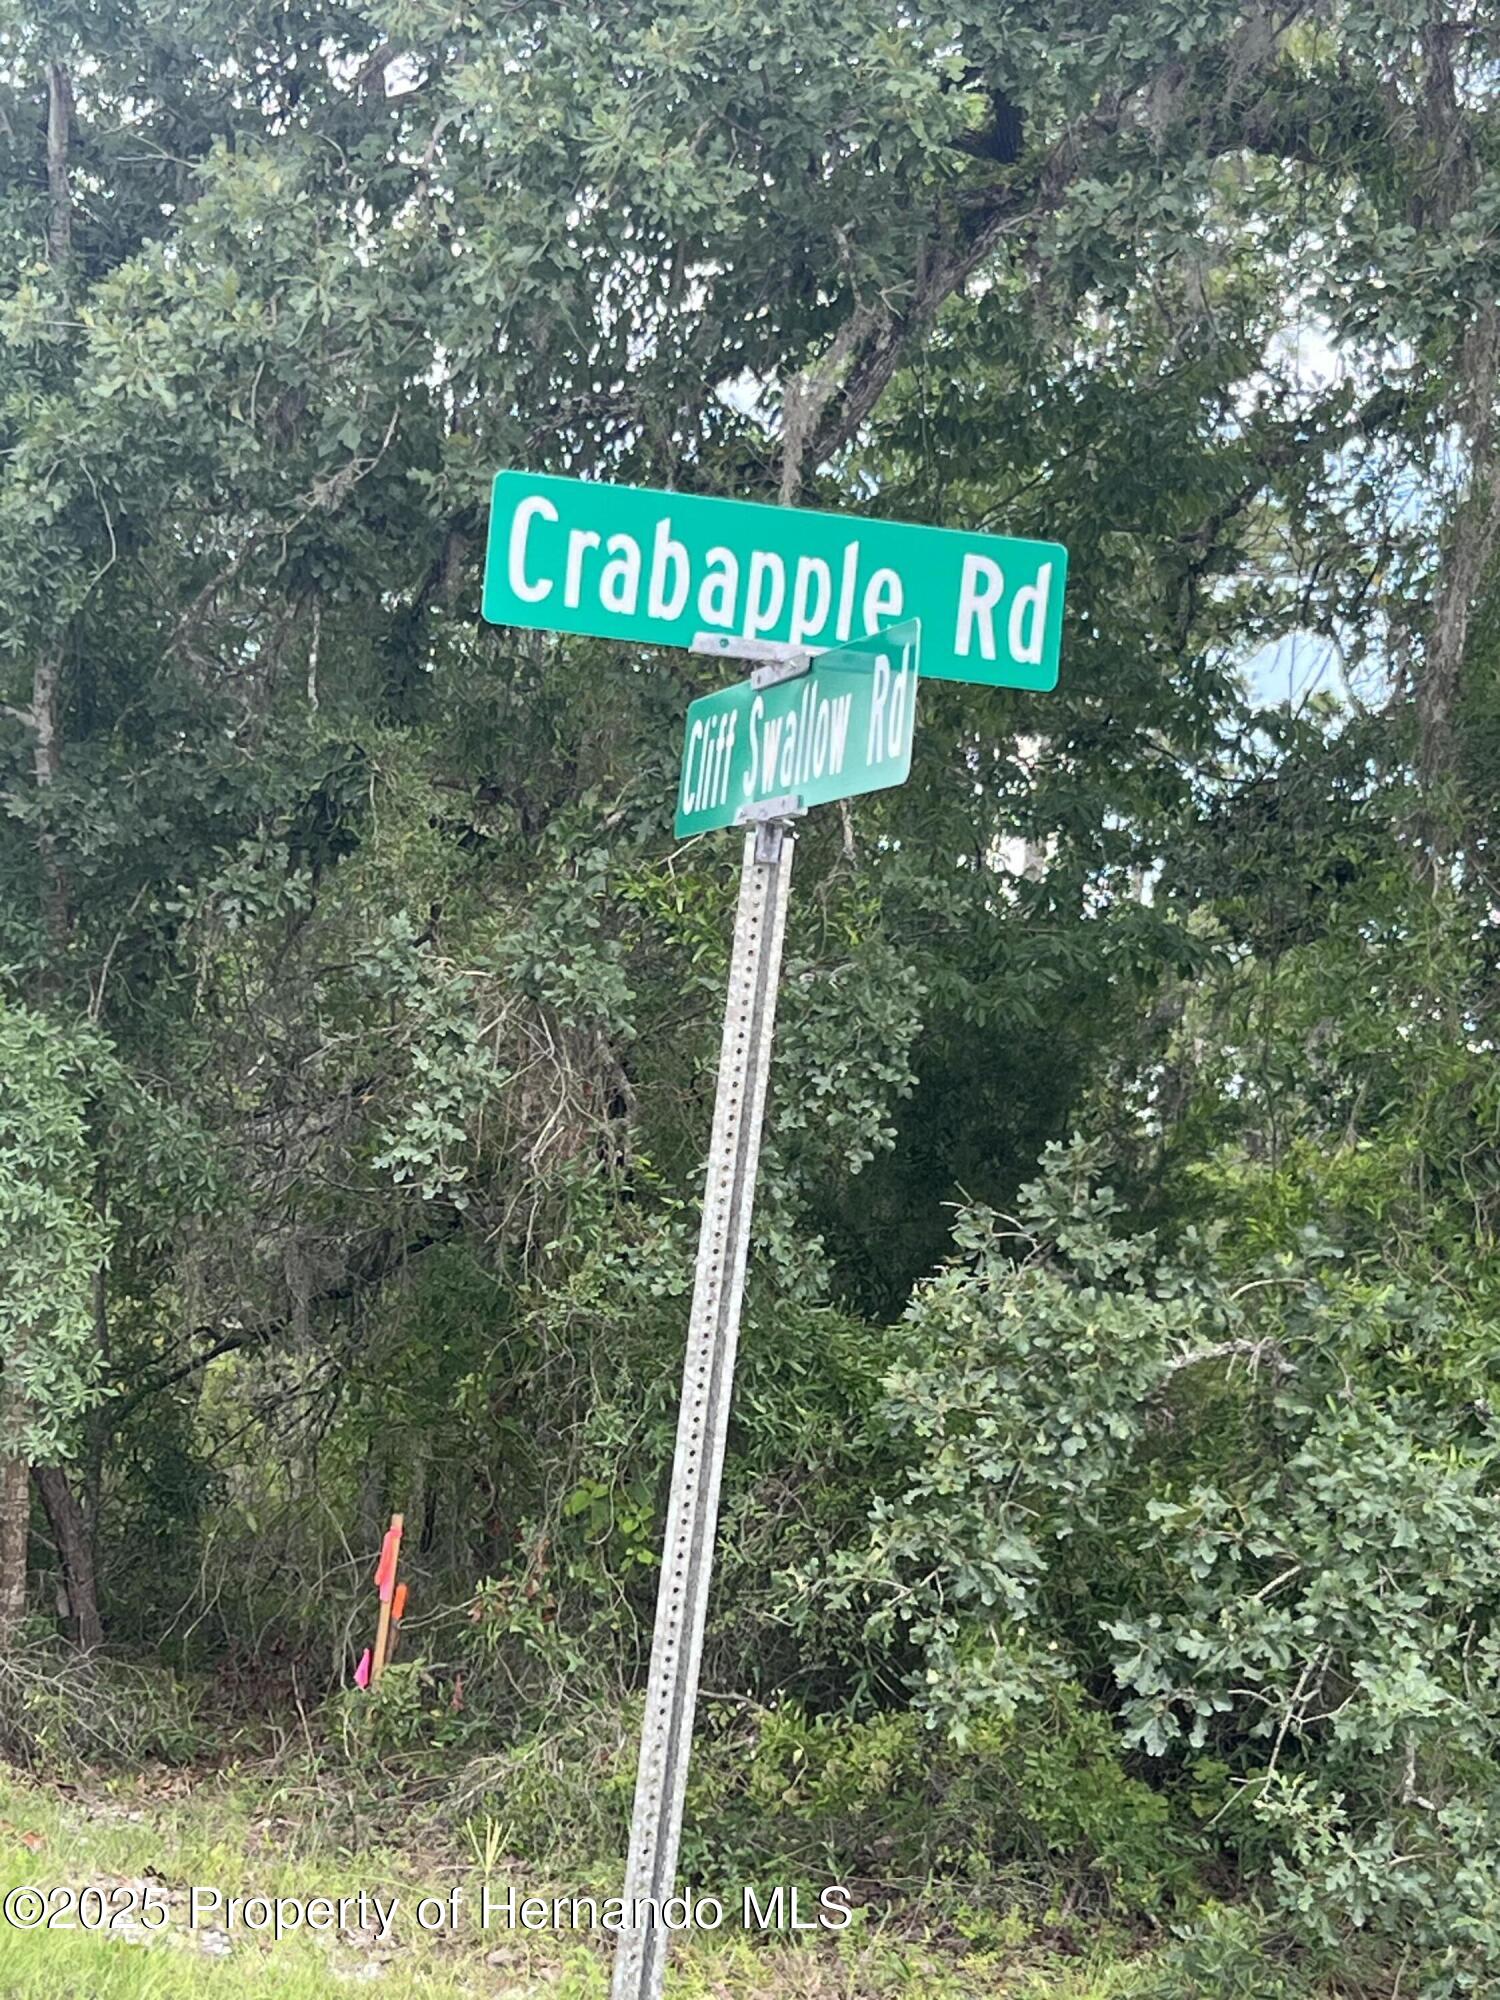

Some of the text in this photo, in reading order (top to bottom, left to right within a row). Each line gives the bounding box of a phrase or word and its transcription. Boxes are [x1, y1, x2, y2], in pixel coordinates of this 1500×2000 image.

[508, 495, 1053, 665] Crabapple Rd
[683, 642, 911, 815] Cliff Swallow Rd
